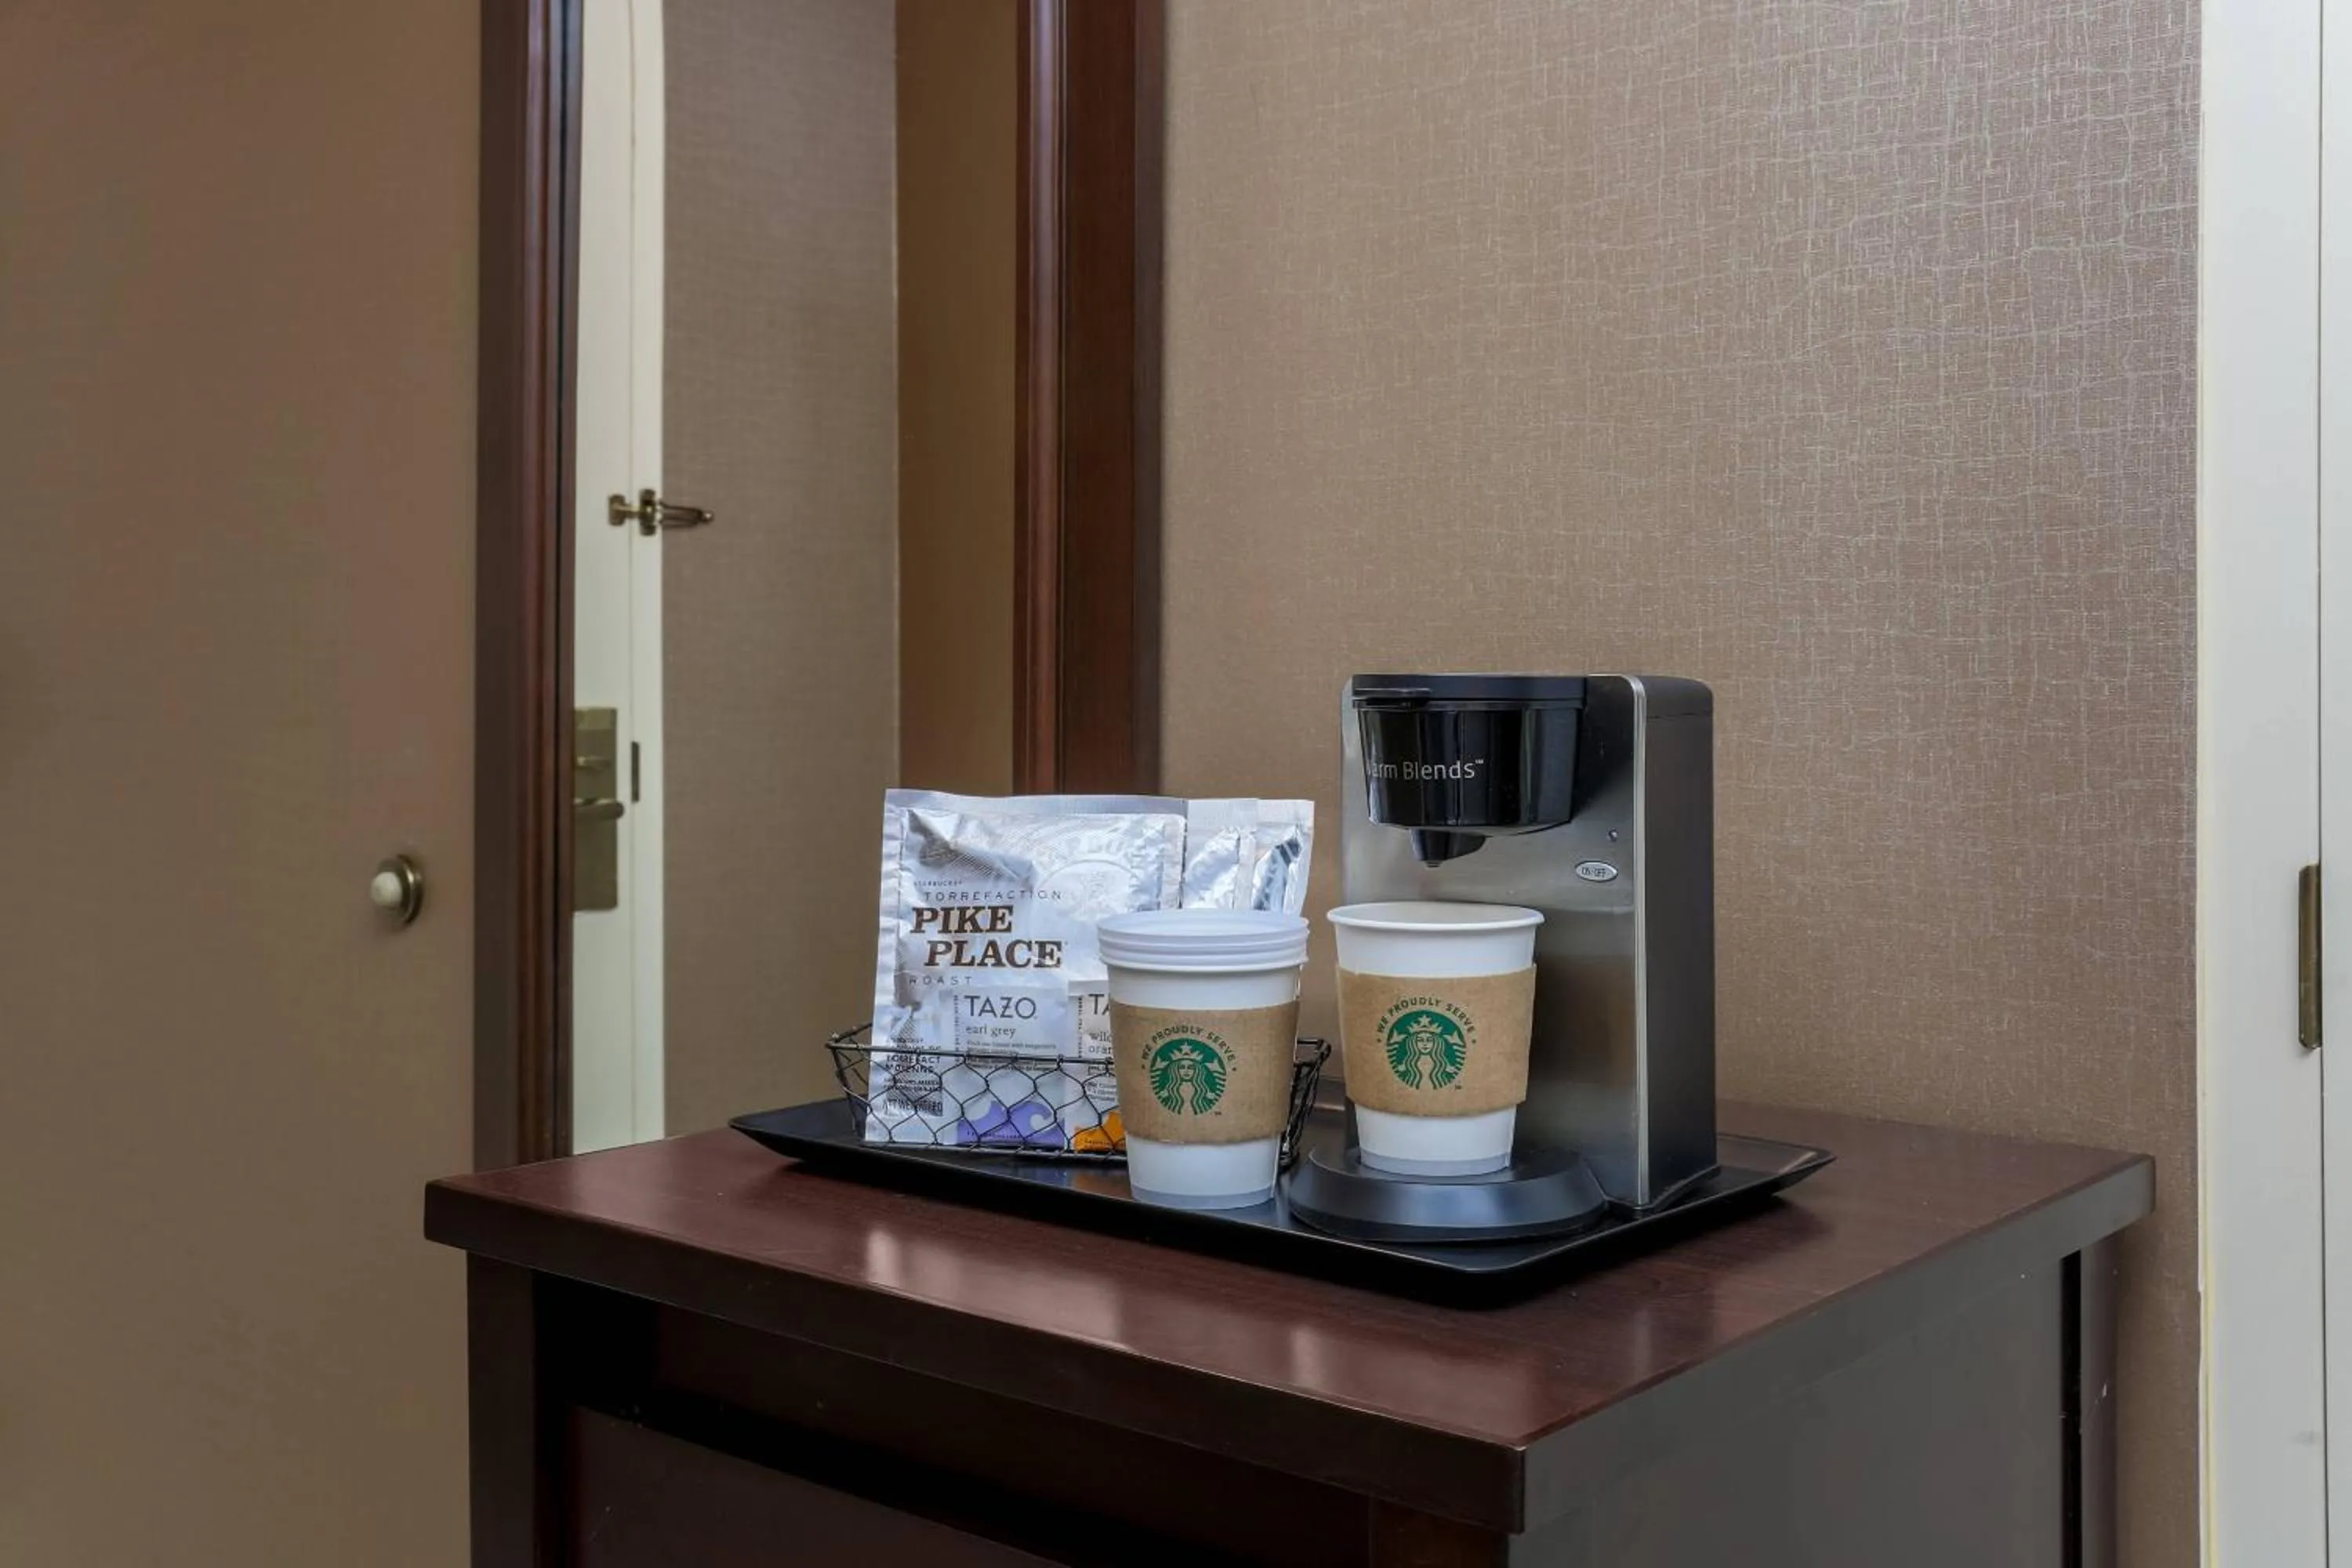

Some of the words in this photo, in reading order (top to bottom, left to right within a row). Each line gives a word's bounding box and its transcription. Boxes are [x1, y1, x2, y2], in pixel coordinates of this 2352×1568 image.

[925, 890, 1062, 902] TORREFACTION
[909, 905, 1014, 934] PIKE
[924, 939, 1062, 968] PLACE
[909, 976, 972, 985] ROAST
[964, 995, 1036, 1019] TAZO
[1377, 1015, 1388, 1033] WE
[1387, 996, 1443, 1017] PROUDLY
[1446, 1004, 1475, 1033] SERVE
[966, 1024, 987, 1034] earl
[991, 1027, 1016, 1038] grey
[1142, 1044, 1152, 1060] WE
[1151, 1025, 1204, 1044] PROUDLY
[1207, 1032, 1236, 1062] SERVE
